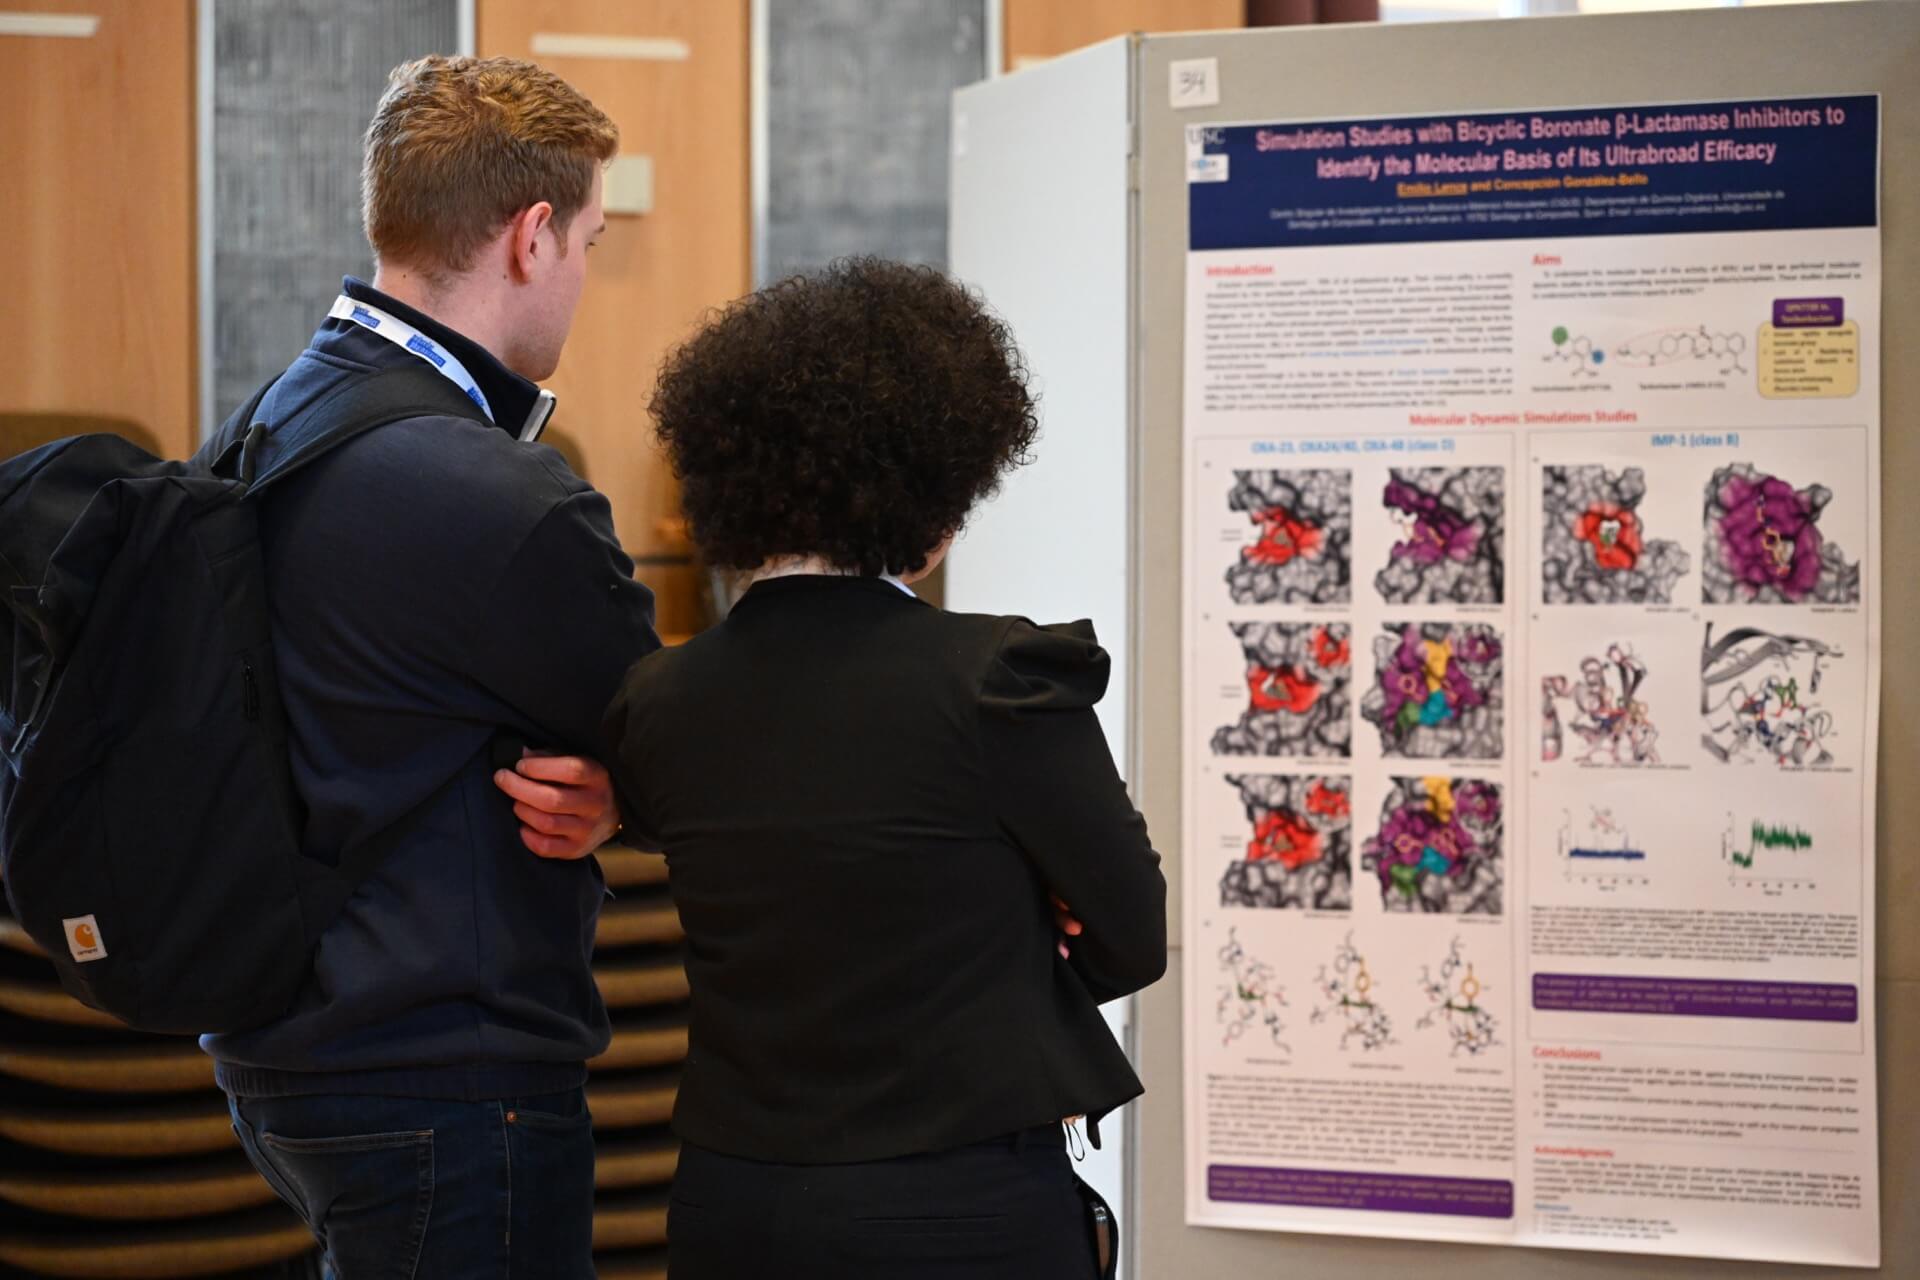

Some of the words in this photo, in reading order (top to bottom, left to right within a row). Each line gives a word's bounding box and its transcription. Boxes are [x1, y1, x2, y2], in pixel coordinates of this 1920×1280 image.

[1179, 71, 1206, 95] 34
[1255, 129, 1345, 152] Simulation
[1349, 123, 1413, 147] Studies
[1417, 122, 1453, 143] with
[1457, 119, 1527, 146] Bicyclic
[1530, 115, 1611, 139] Boronate
[1615, 110, 1729, 139] β-Lactamase
[1733, 107, 1821, 129] Inhibitors
[1825, 105, 1846, 125] to
[1316, 155, 1381, 181] Identify
[1384, 157, 1411, 175] the
[1415, 151, 1499, 174] Molecular
[1503, 148, 1552, 170] Basis
[1556, 147, 1576, 168] of
[1579, 146, 1600, 167] Its
[1605, 141, 1699, 165] Ultrabroad
[1703, 139, 1777, 164] Efficacy
[1532, 253, 1562, 266] Aims
[1205, 263, 1274, 276] Introduction
[1409, 412, 1466, 426] Molecular
[1470, 411, 1520, 427] Dynamic
[1523, 410, 1591, 424] Simulations
[1595, 408, 1637, 423] Studies
[1532, 1046, 1602, 1060] Conclusions
